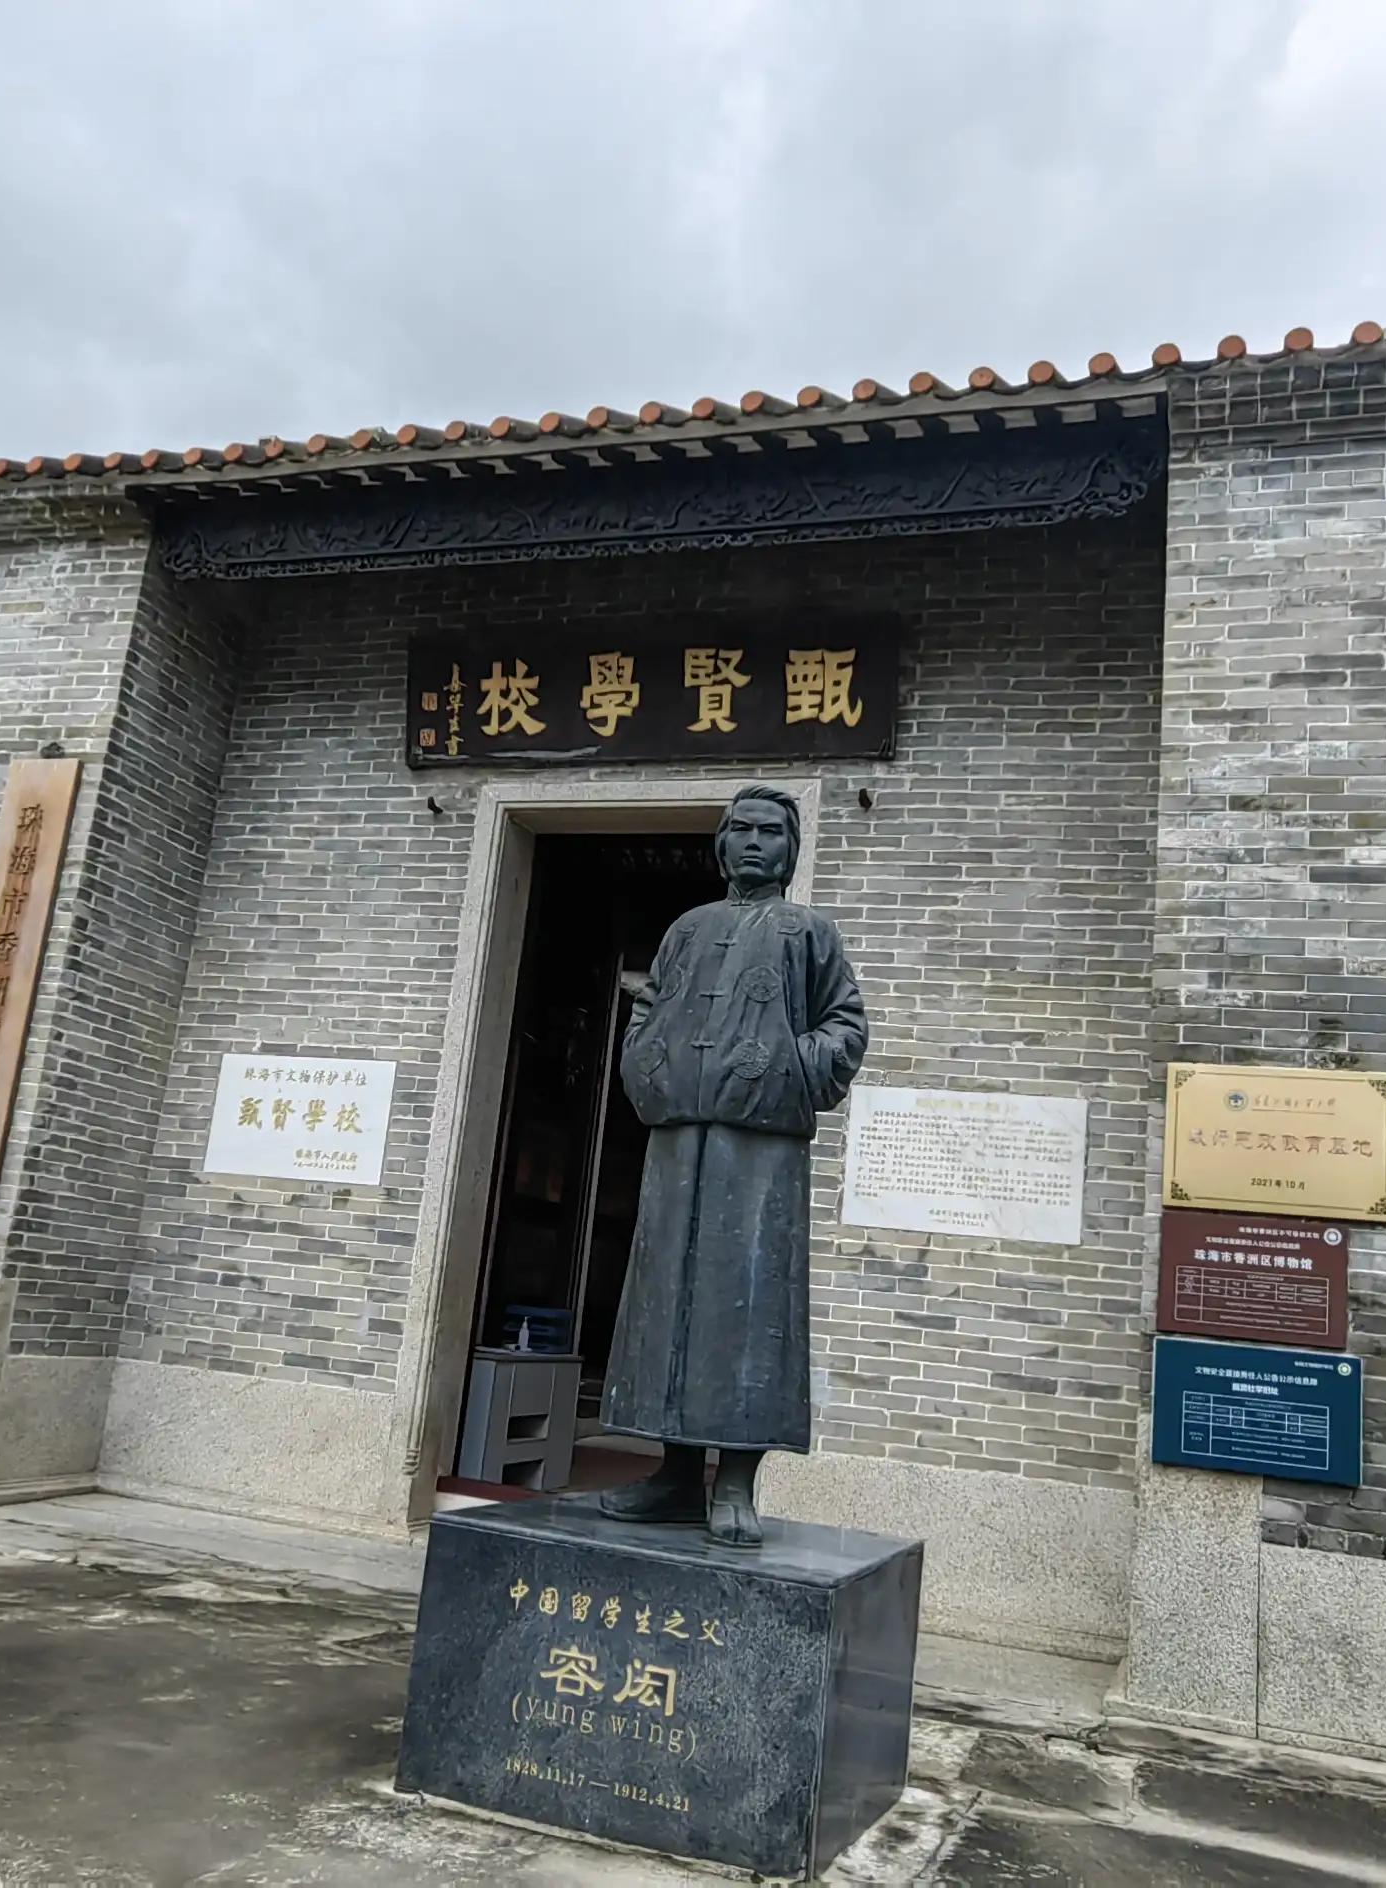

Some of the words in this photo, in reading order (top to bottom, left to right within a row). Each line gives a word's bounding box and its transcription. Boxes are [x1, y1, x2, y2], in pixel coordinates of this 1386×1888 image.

[476, 647, 863, 737] 甄賢學校
[244, 1067, 367, 1086] 珠海市文物保护单位
[1194, 1248, 1313, 1270] 珠海市香洲区博物馆
[509, 1577, 724, 1646] 中国留学生之父
[539, 1644, 677, 1717] 容闳
[511, 1691, 596, 1735] (yung
[610, 1711, 697, 1762] wing)
